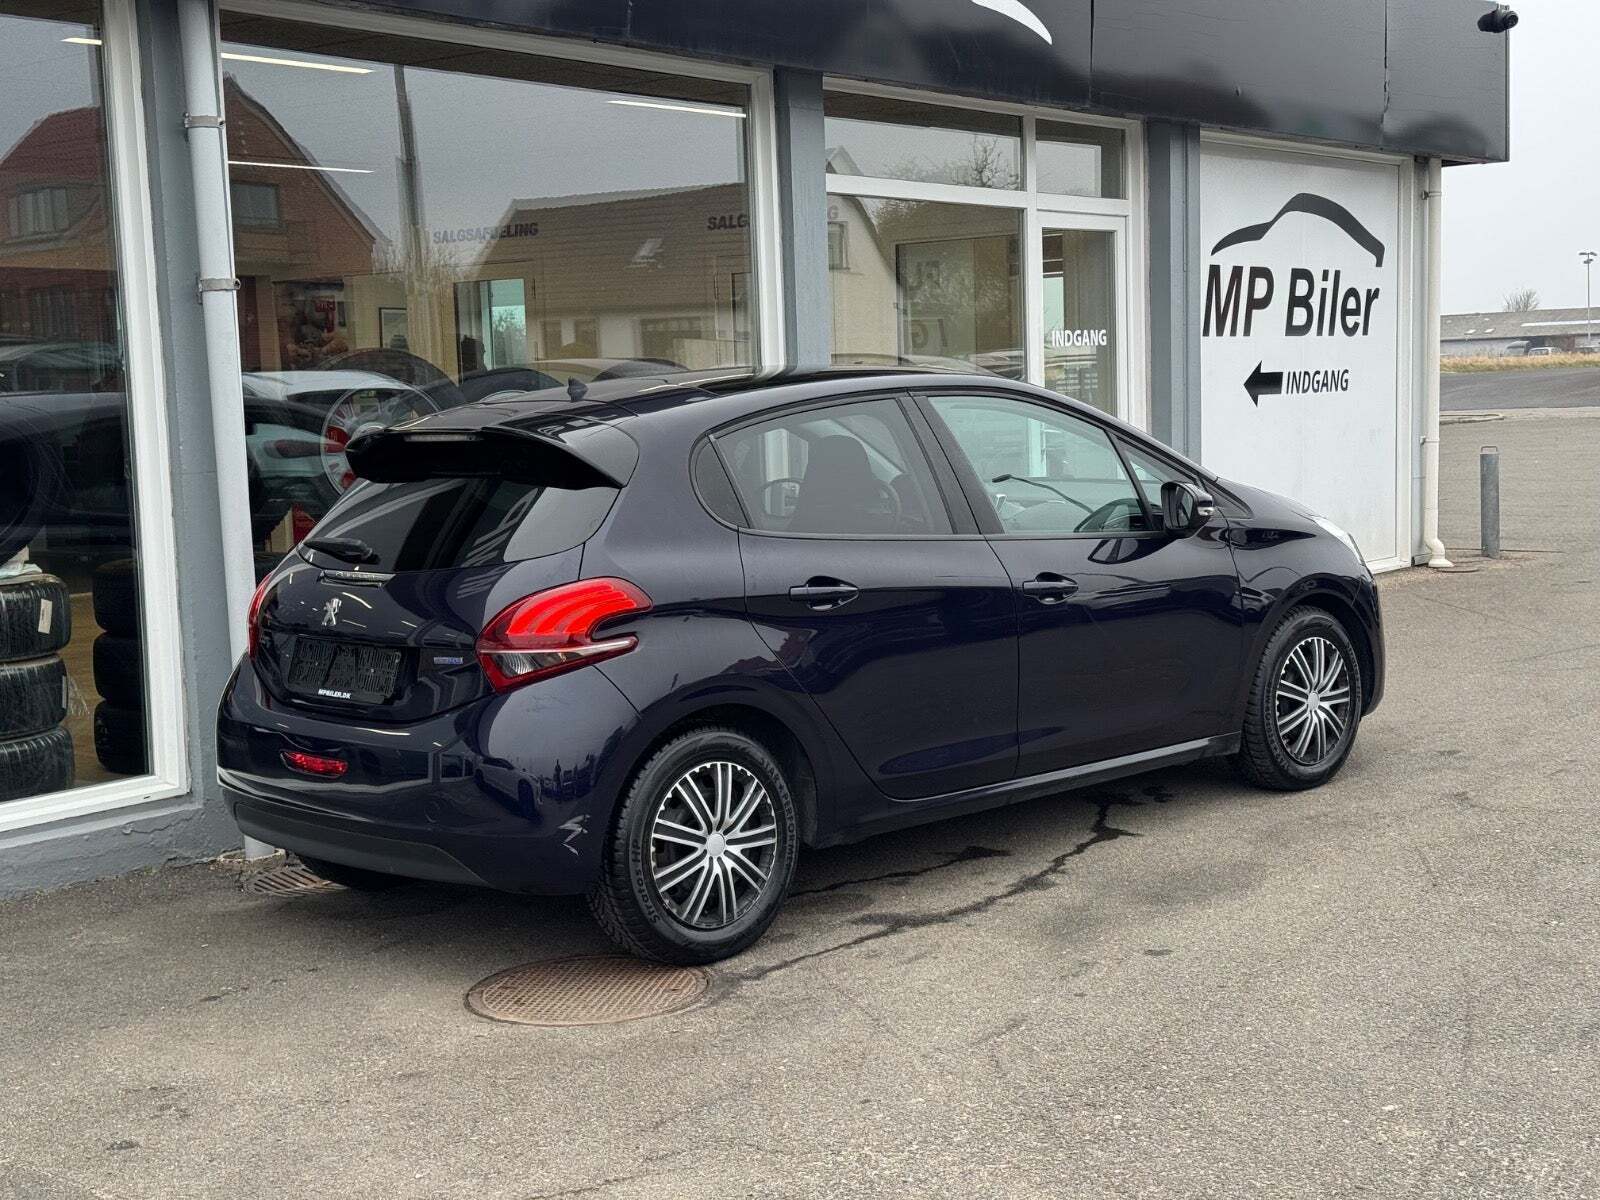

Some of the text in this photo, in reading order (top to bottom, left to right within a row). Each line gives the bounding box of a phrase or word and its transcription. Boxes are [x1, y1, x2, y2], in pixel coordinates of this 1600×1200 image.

[707, 213, 750, 231] SALG
[1202, 264, 1380, 337] MP Biler
[1052, 329, 1107, 347] INDGANG
[1286, 369, 1349, 394] INDGANG
